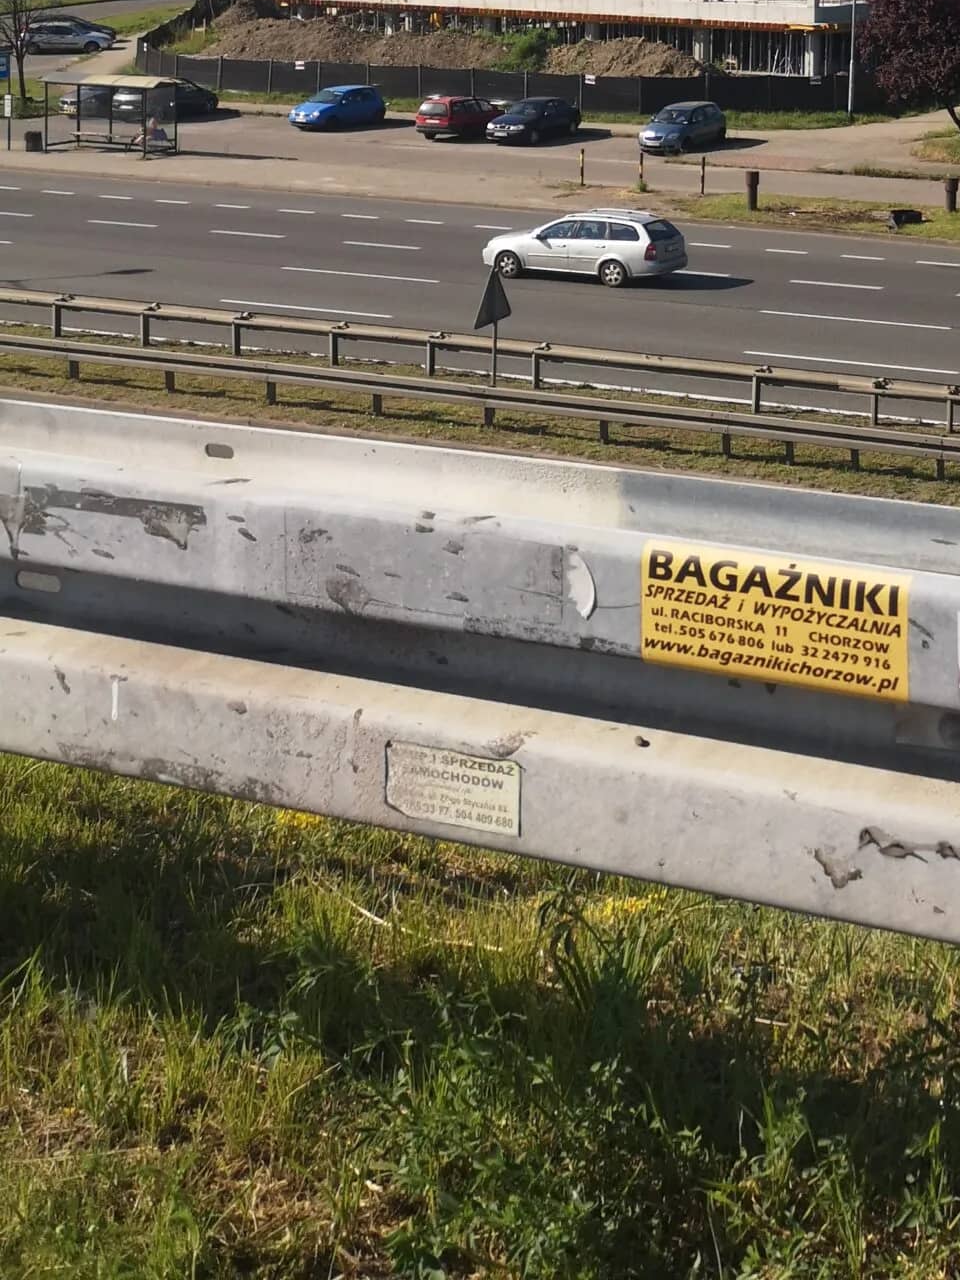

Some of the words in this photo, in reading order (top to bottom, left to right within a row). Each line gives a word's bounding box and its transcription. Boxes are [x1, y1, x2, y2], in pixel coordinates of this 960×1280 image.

[648, 549, 900, 617] BAGAŻNIKI
[645, 584, 731, 610] SPRZEDAŻ
[737, 595, 745, 613] i
[753, 601, 901, 638] WYPOŻYCZALNIA
[651, 606, 668, 619] ul.
[670, 608, 765, 634] RACIBORSKA
[775, 625, 788, 637] 11
[644, 637, 899, 693] www.bagaznikichorzow.pl
[709, 630, 735, 645] 676
[738, 635, 765, 650] 806
[771, 640, 795, 654] lub
[801, 645, 823, 659] 32
[863, 655, 891, 670] 916
[440, 755, 515, 776] SPRZEDAŻ
